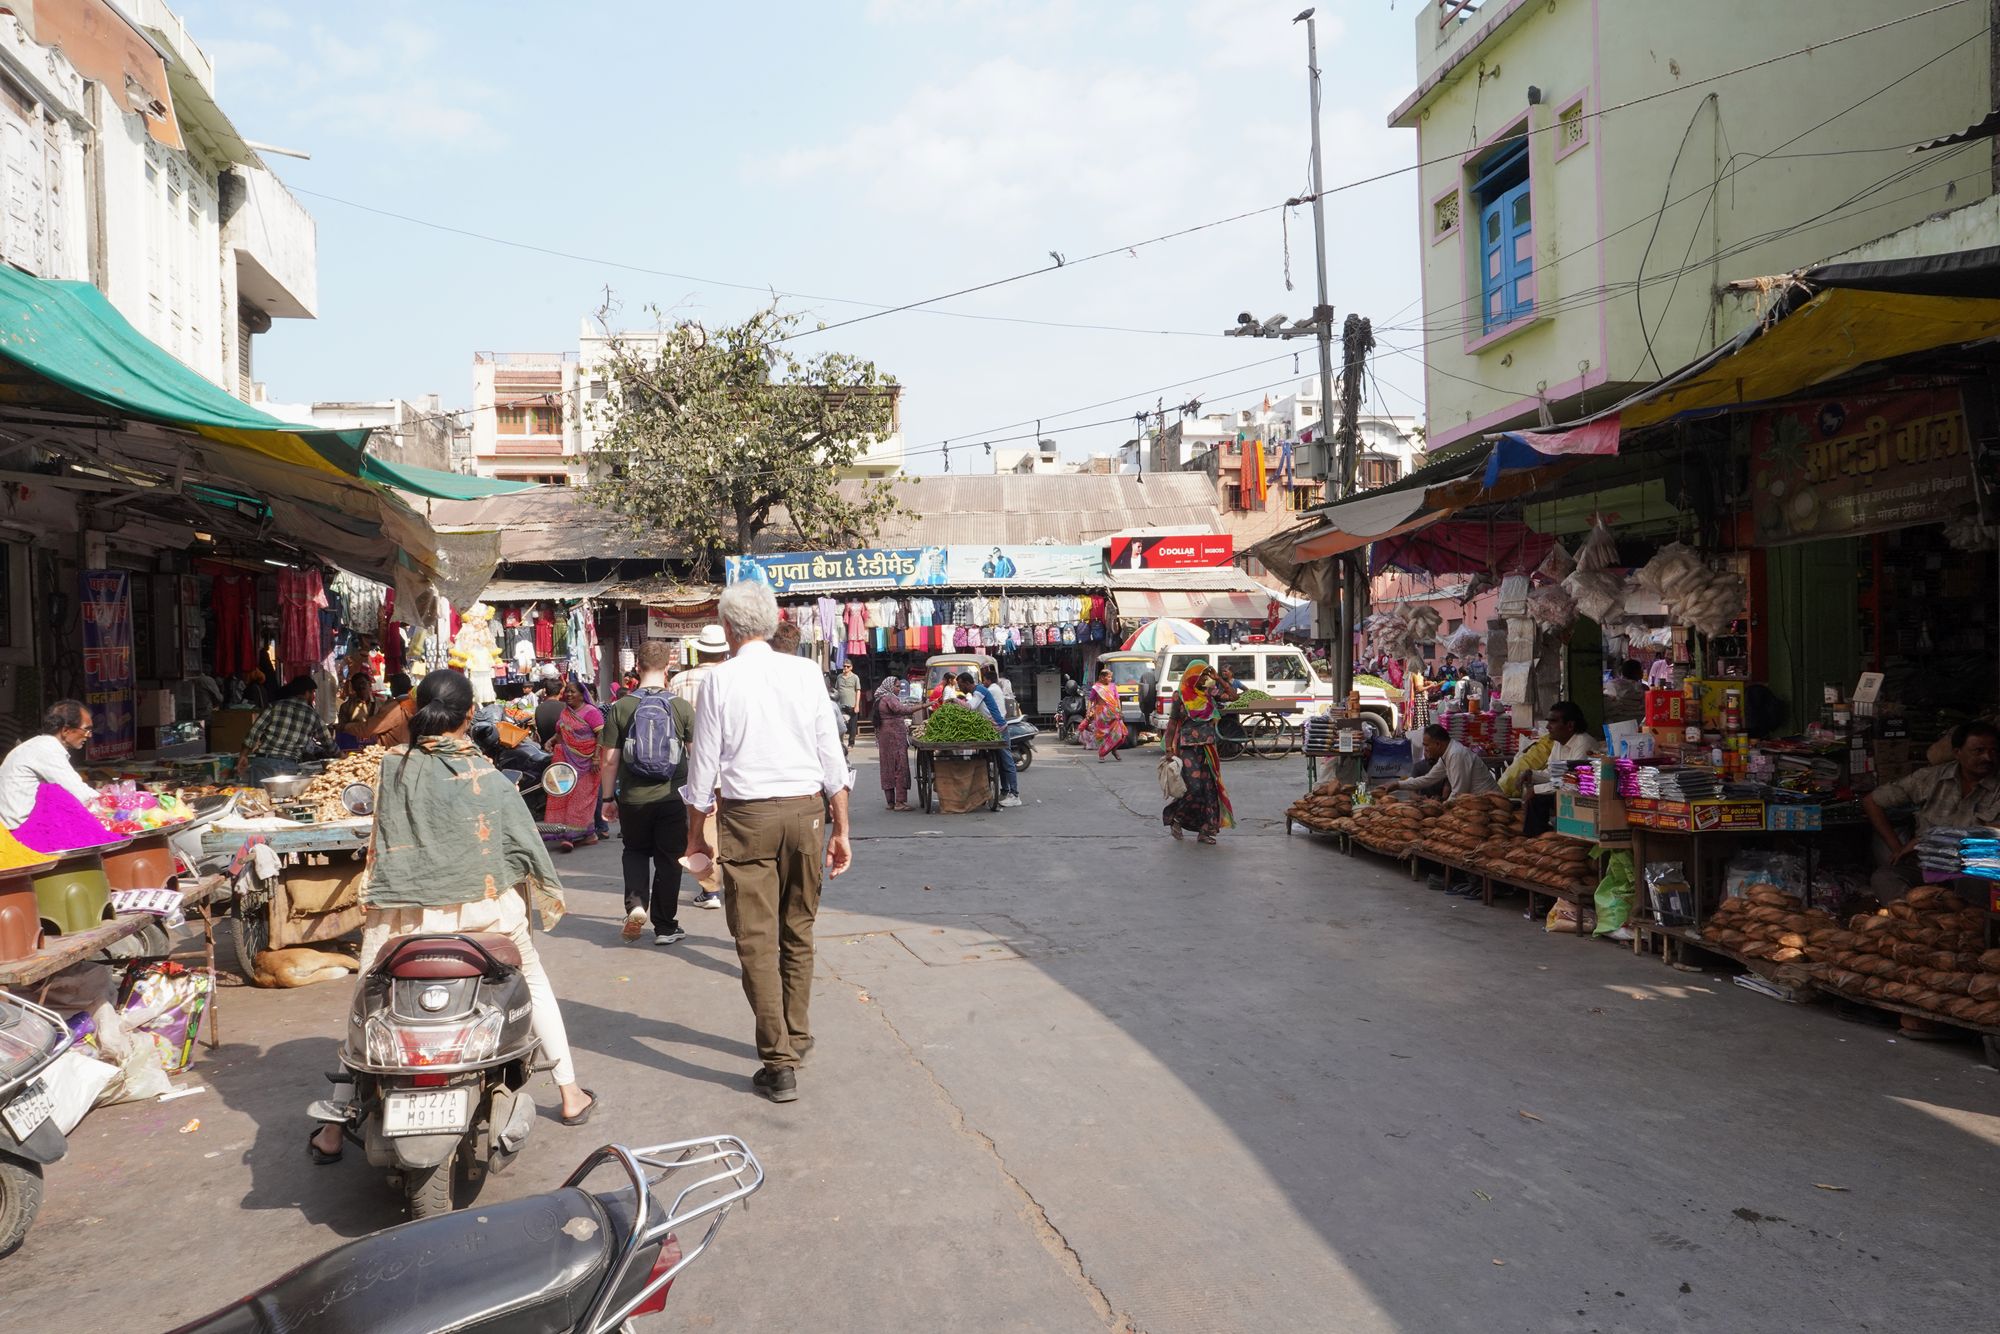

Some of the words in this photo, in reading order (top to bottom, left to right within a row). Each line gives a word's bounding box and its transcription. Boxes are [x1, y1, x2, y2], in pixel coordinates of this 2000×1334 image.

[768, 563, 809, 587] गुप्ता
[812, 554, 841, 580] बैग
[845, 561, 855, 577] &
[858, 552, 915, 577] रेडीमेड
[1672, 698, 1680, 719] ROSE
[1637, 741, 1646, 758] Opal
[415, 954, 465, 964] SUZUKI
[408, 1093, 457, 1109] RJ27A
[407, 1109, 457, 1127] M9115
